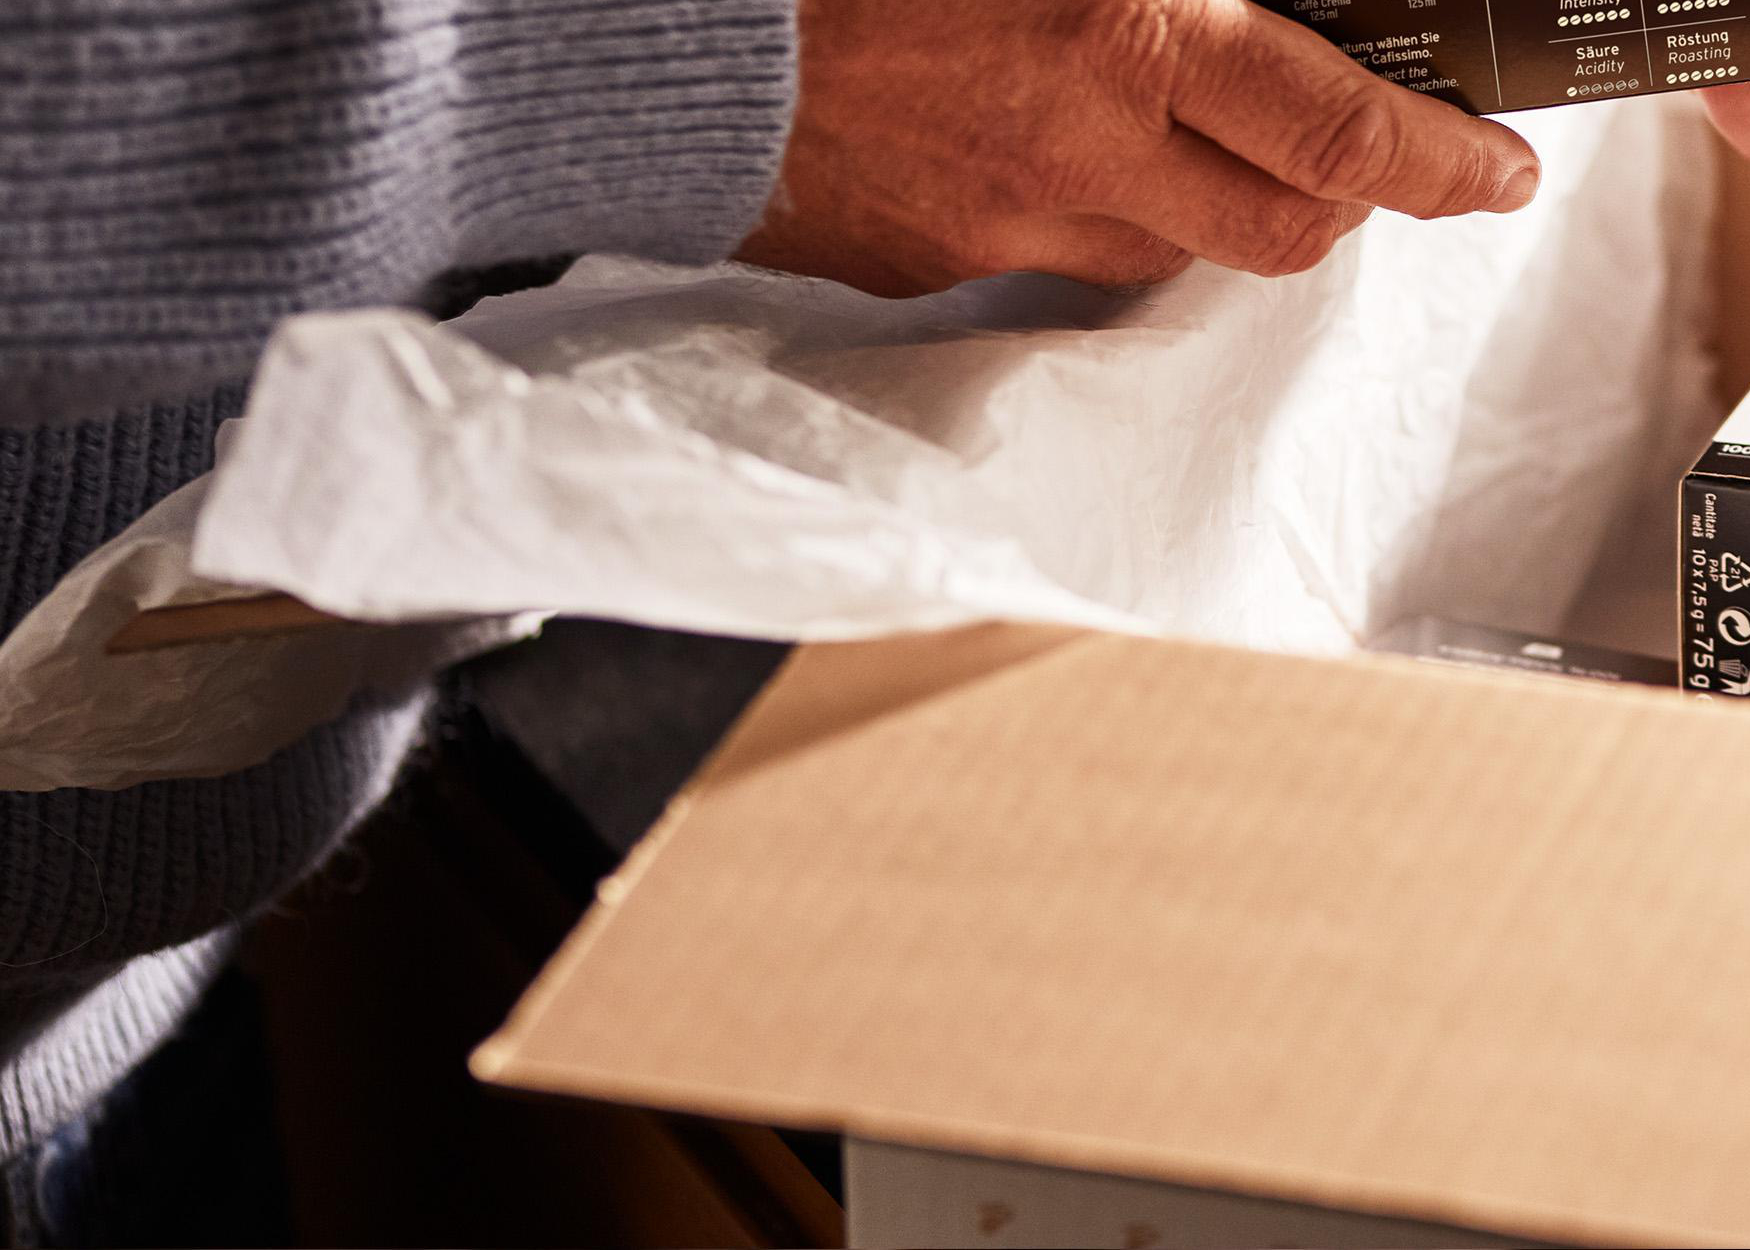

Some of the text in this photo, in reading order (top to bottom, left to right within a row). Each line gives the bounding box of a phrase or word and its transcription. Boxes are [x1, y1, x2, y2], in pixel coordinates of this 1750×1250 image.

[1341, 32, 1440, 54] itung wählen Sie
[1667, 31, 1728, 48] Röstung
[1371, 49, 1433, 65] Cafissimo.
[1576, 45, 1619, 59] Säure
[1668, 46, 1730, 64] Roasting
[1380, 67, 1429, 81] elect the
[1574, 60, 1624, 76] Acidity
[1409, 77, 1460, 92] machine.
[1705, 493, 1717, 539] Cantitate
[1691, 514, 1704, 537] netă
[1708, 558, 1719, 581] PAP
[1689, 549, 1714, 687] 10 x 7,5 g = 75 g
